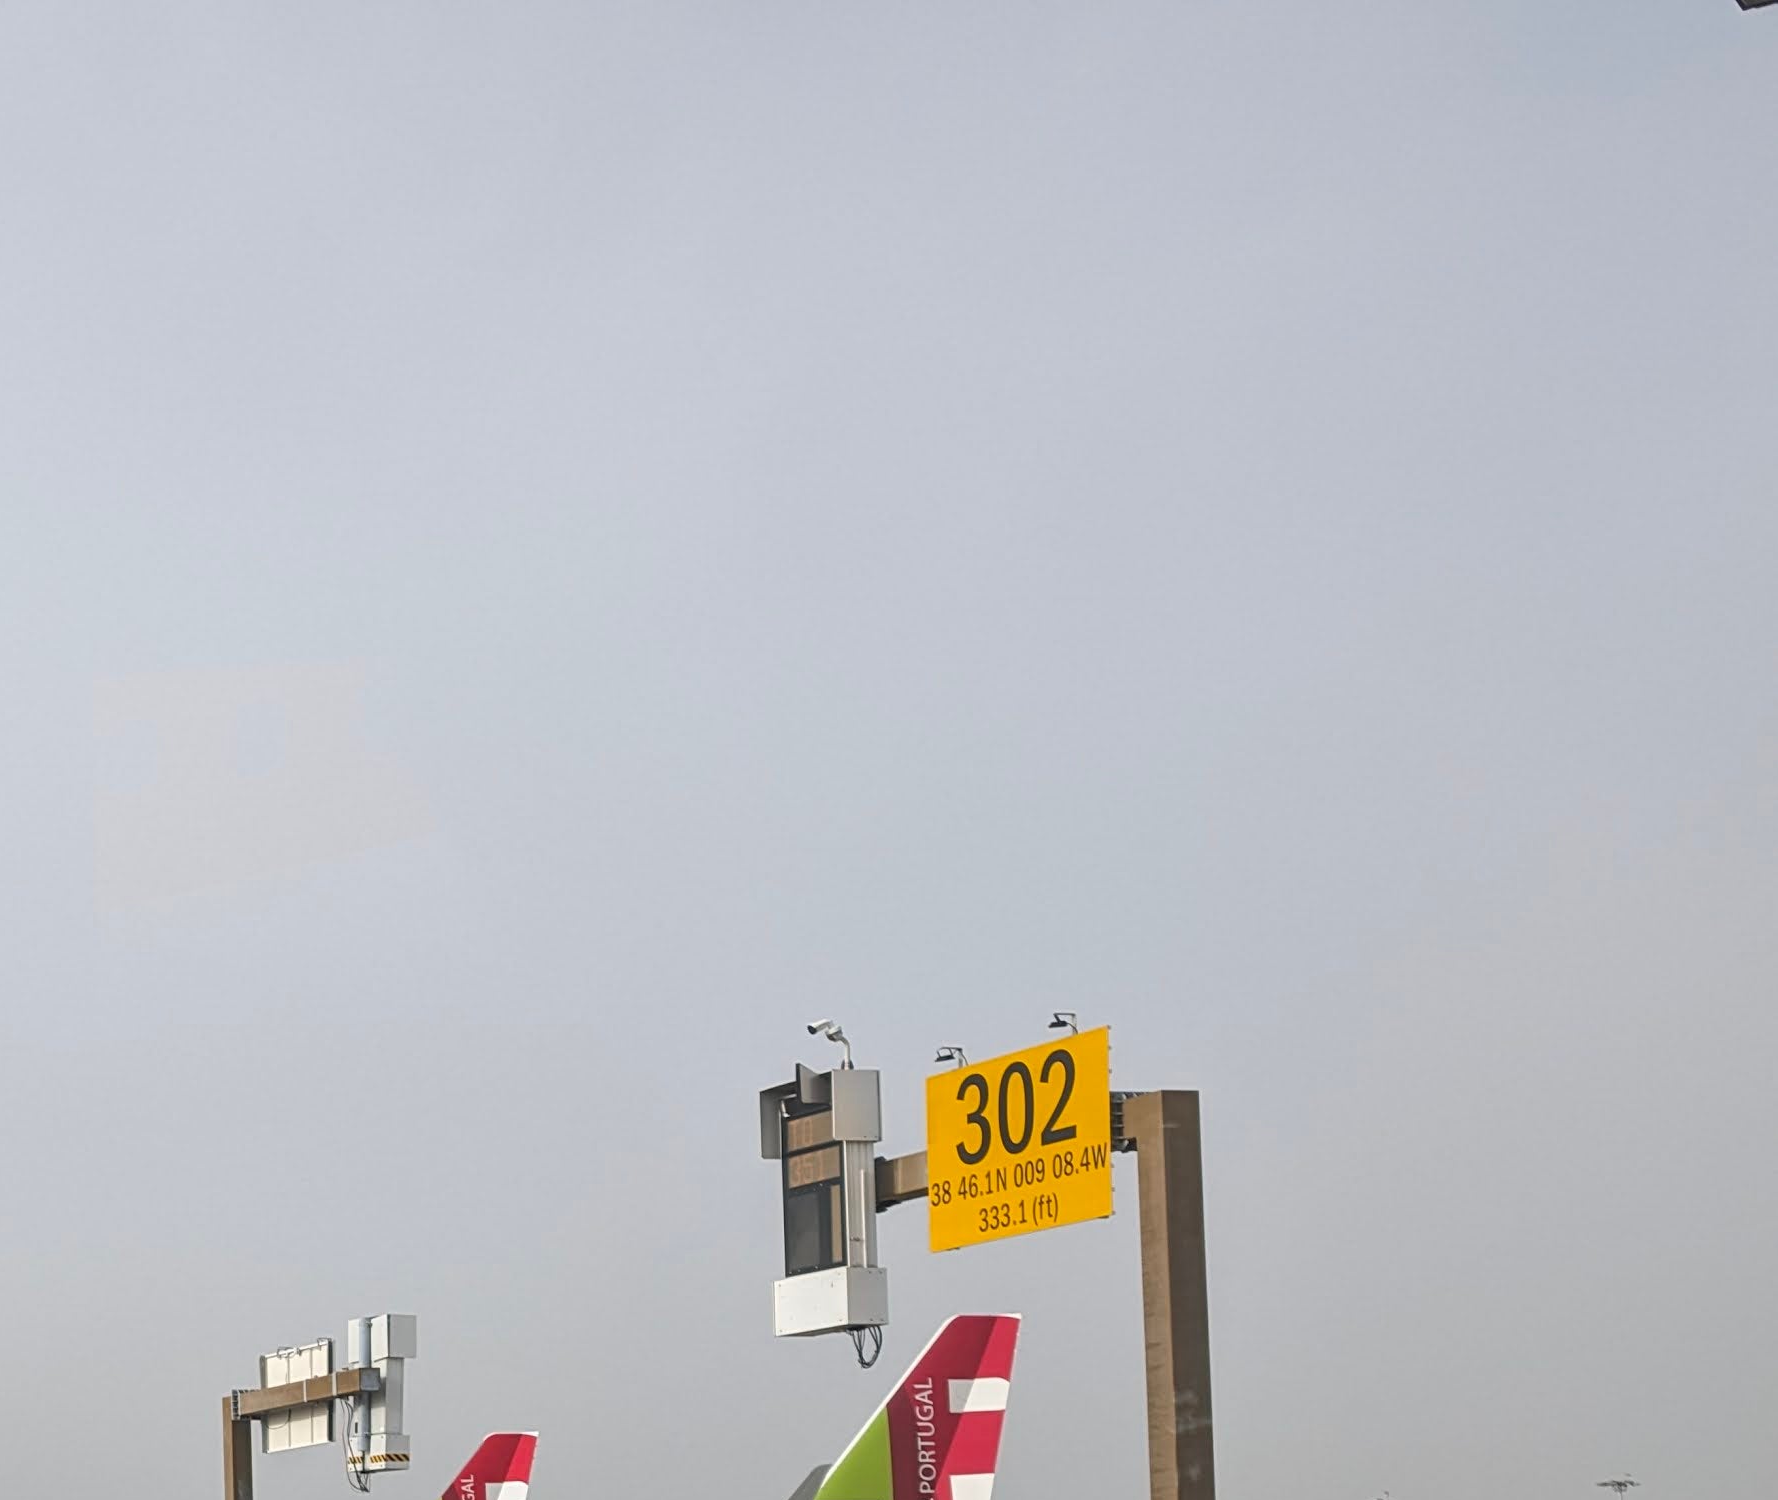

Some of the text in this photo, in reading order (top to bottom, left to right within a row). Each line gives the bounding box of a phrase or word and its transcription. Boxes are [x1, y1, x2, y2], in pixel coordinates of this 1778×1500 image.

[956, 1049, 1077, 1165] 302
[931, 1143, 1108, 1207] 38 46.1N 009 08.4W
[979, 1193, 1059, 1232] 333.1 (ft)
[913, 1377, 936, 1494] PORTUGAL
